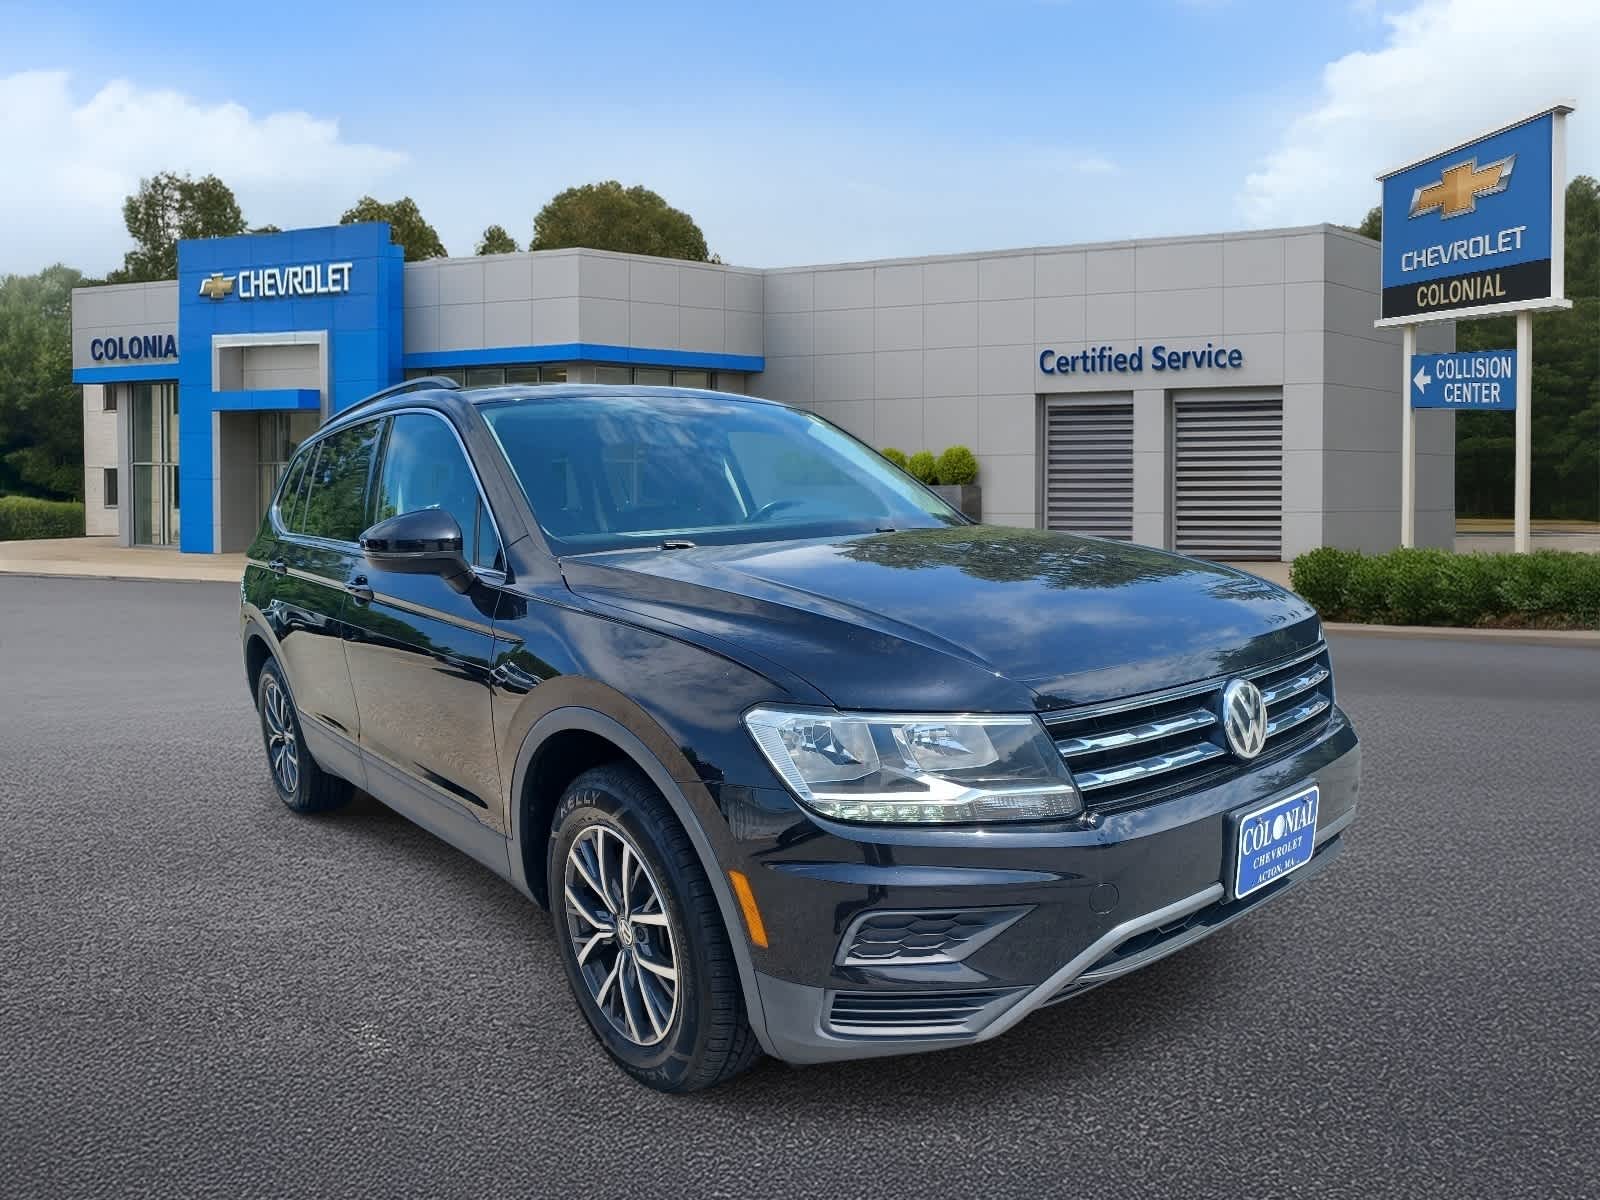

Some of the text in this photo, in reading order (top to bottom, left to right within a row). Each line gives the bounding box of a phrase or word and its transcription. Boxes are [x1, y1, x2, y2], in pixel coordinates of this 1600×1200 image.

[1401, 226, 1527, 272] CHEVROLET
[238, 262, 353, 298] CHEVROLET
[1416, 274, 1506, 307] COLONIAL
[91, 335, 177, 361] COLONIA
[1039, 343, 1243, 374] Certified Service
[1436, 357, 1512, 380] COLLISION
[1444, 383, 1501, 403] CENTER
[560, 791, 600, 819] KELLY
[1242, 800, 1315, 856] COLONIAL
[1253, 836, 1303, 870] CHEVROLET
[1257, 864, 1283, 883] ACTON,
